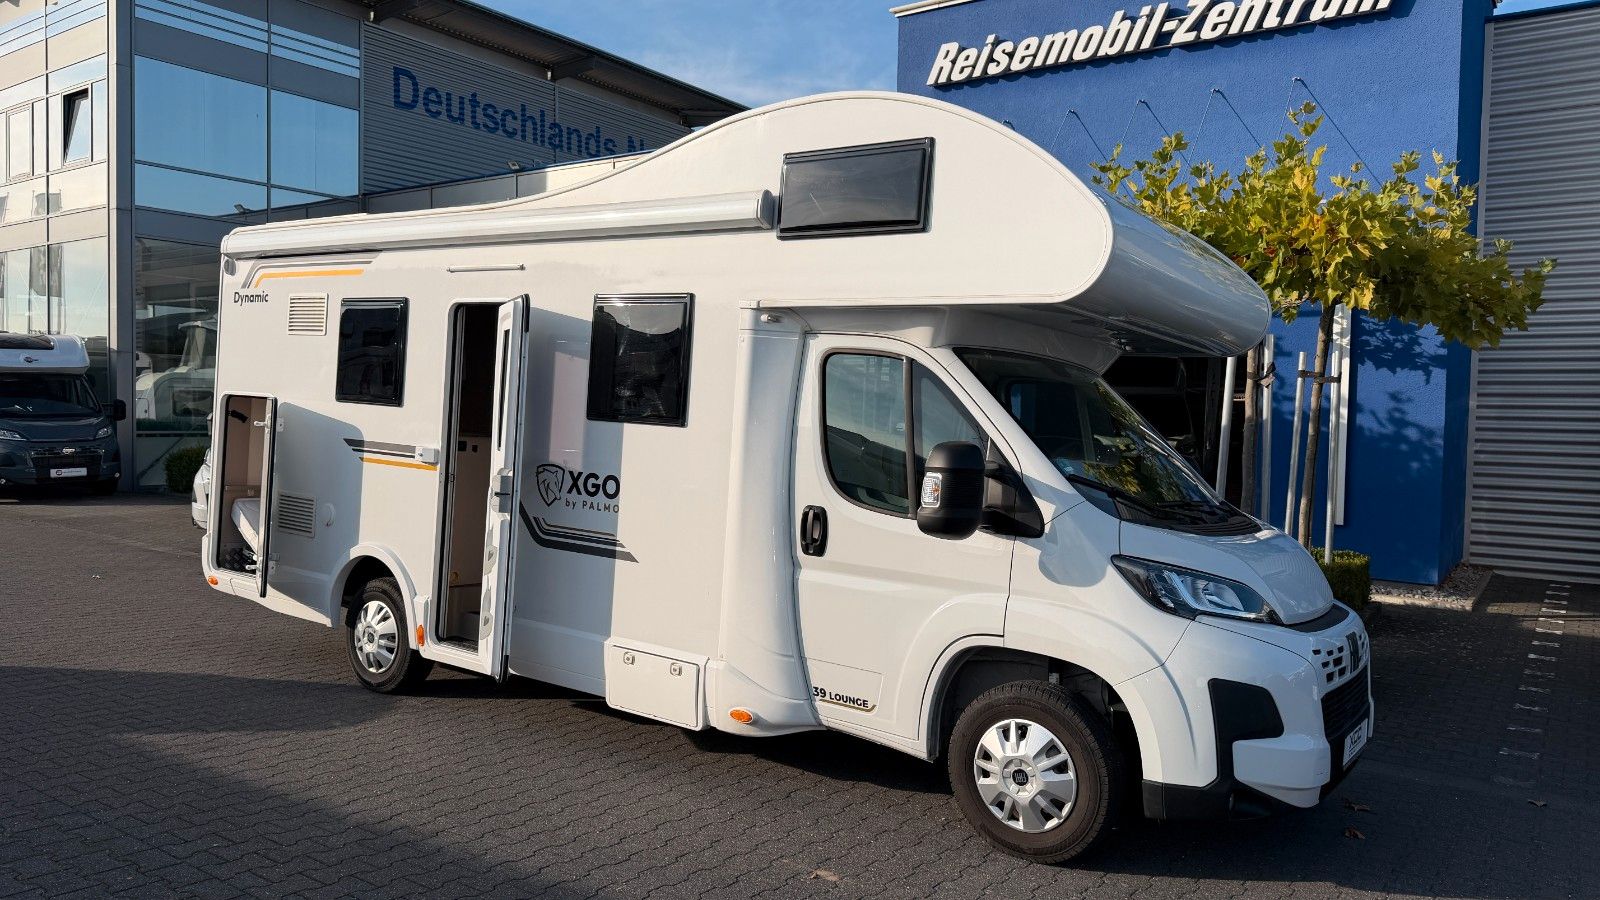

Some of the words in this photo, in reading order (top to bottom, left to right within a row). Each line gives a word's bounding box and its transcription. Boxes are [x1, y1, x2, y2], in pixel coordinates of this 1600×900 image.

[392, 66, 617, 158] Deutschlands
[233, 290, 269, 306] Dynamic
[566, 470, 620, 499] XGO
[565, 498, 577, 510] by
[582, 501, 619, 513] PALMO
[813, 685, 827, 699] 39
[828, 691, 869, 708] LOUNGE
